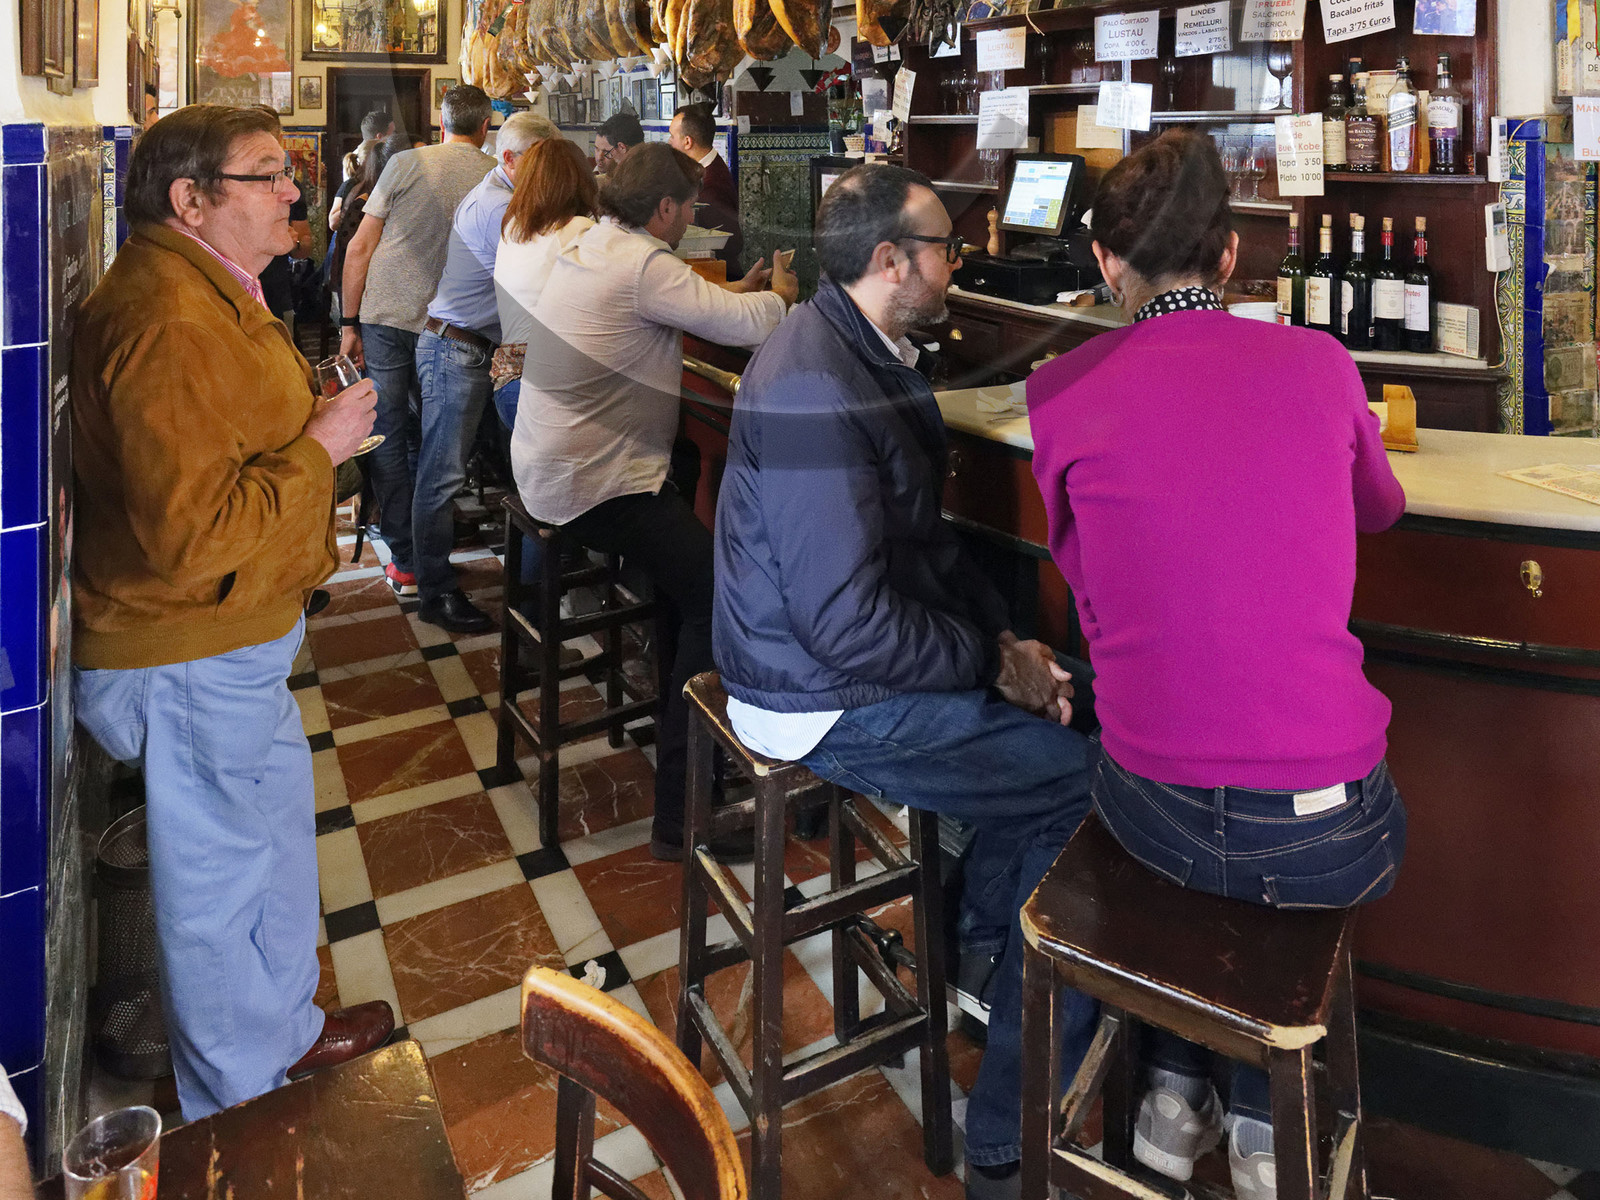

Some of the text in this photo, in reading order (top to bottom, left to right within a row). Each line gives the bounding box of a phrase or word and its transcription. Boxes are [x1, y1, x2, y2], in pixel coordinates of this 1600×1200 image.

[1190, 7, 1216, 17] LINDES
[1252, 10, 1296, 19] SALCHICHA
[1330, 0, 1384, 19] Bacalao fritas
[1120, 17, 1150, 26] CORTADO
[1183, 18, 1223, 29] REMELLURI
[1108, 28, 1144, 39] LUSTAU
[1326, 26, 1347, 37] Tapa
[1349, 20, 1367, 32] 3'75
[987, 42, 1015, 52] LUSTAU
[1103, 42, 1120, 50] COPA
[1110, 50, 1119, 58] 50
[1130, 48, 1150, 56] 20.00
[1298, 142, 1321, 151] Kobe
[1278, 157, 1321, 168] Tapa 3'50
[1280, 173, 1322, 182] Plato 10'00
